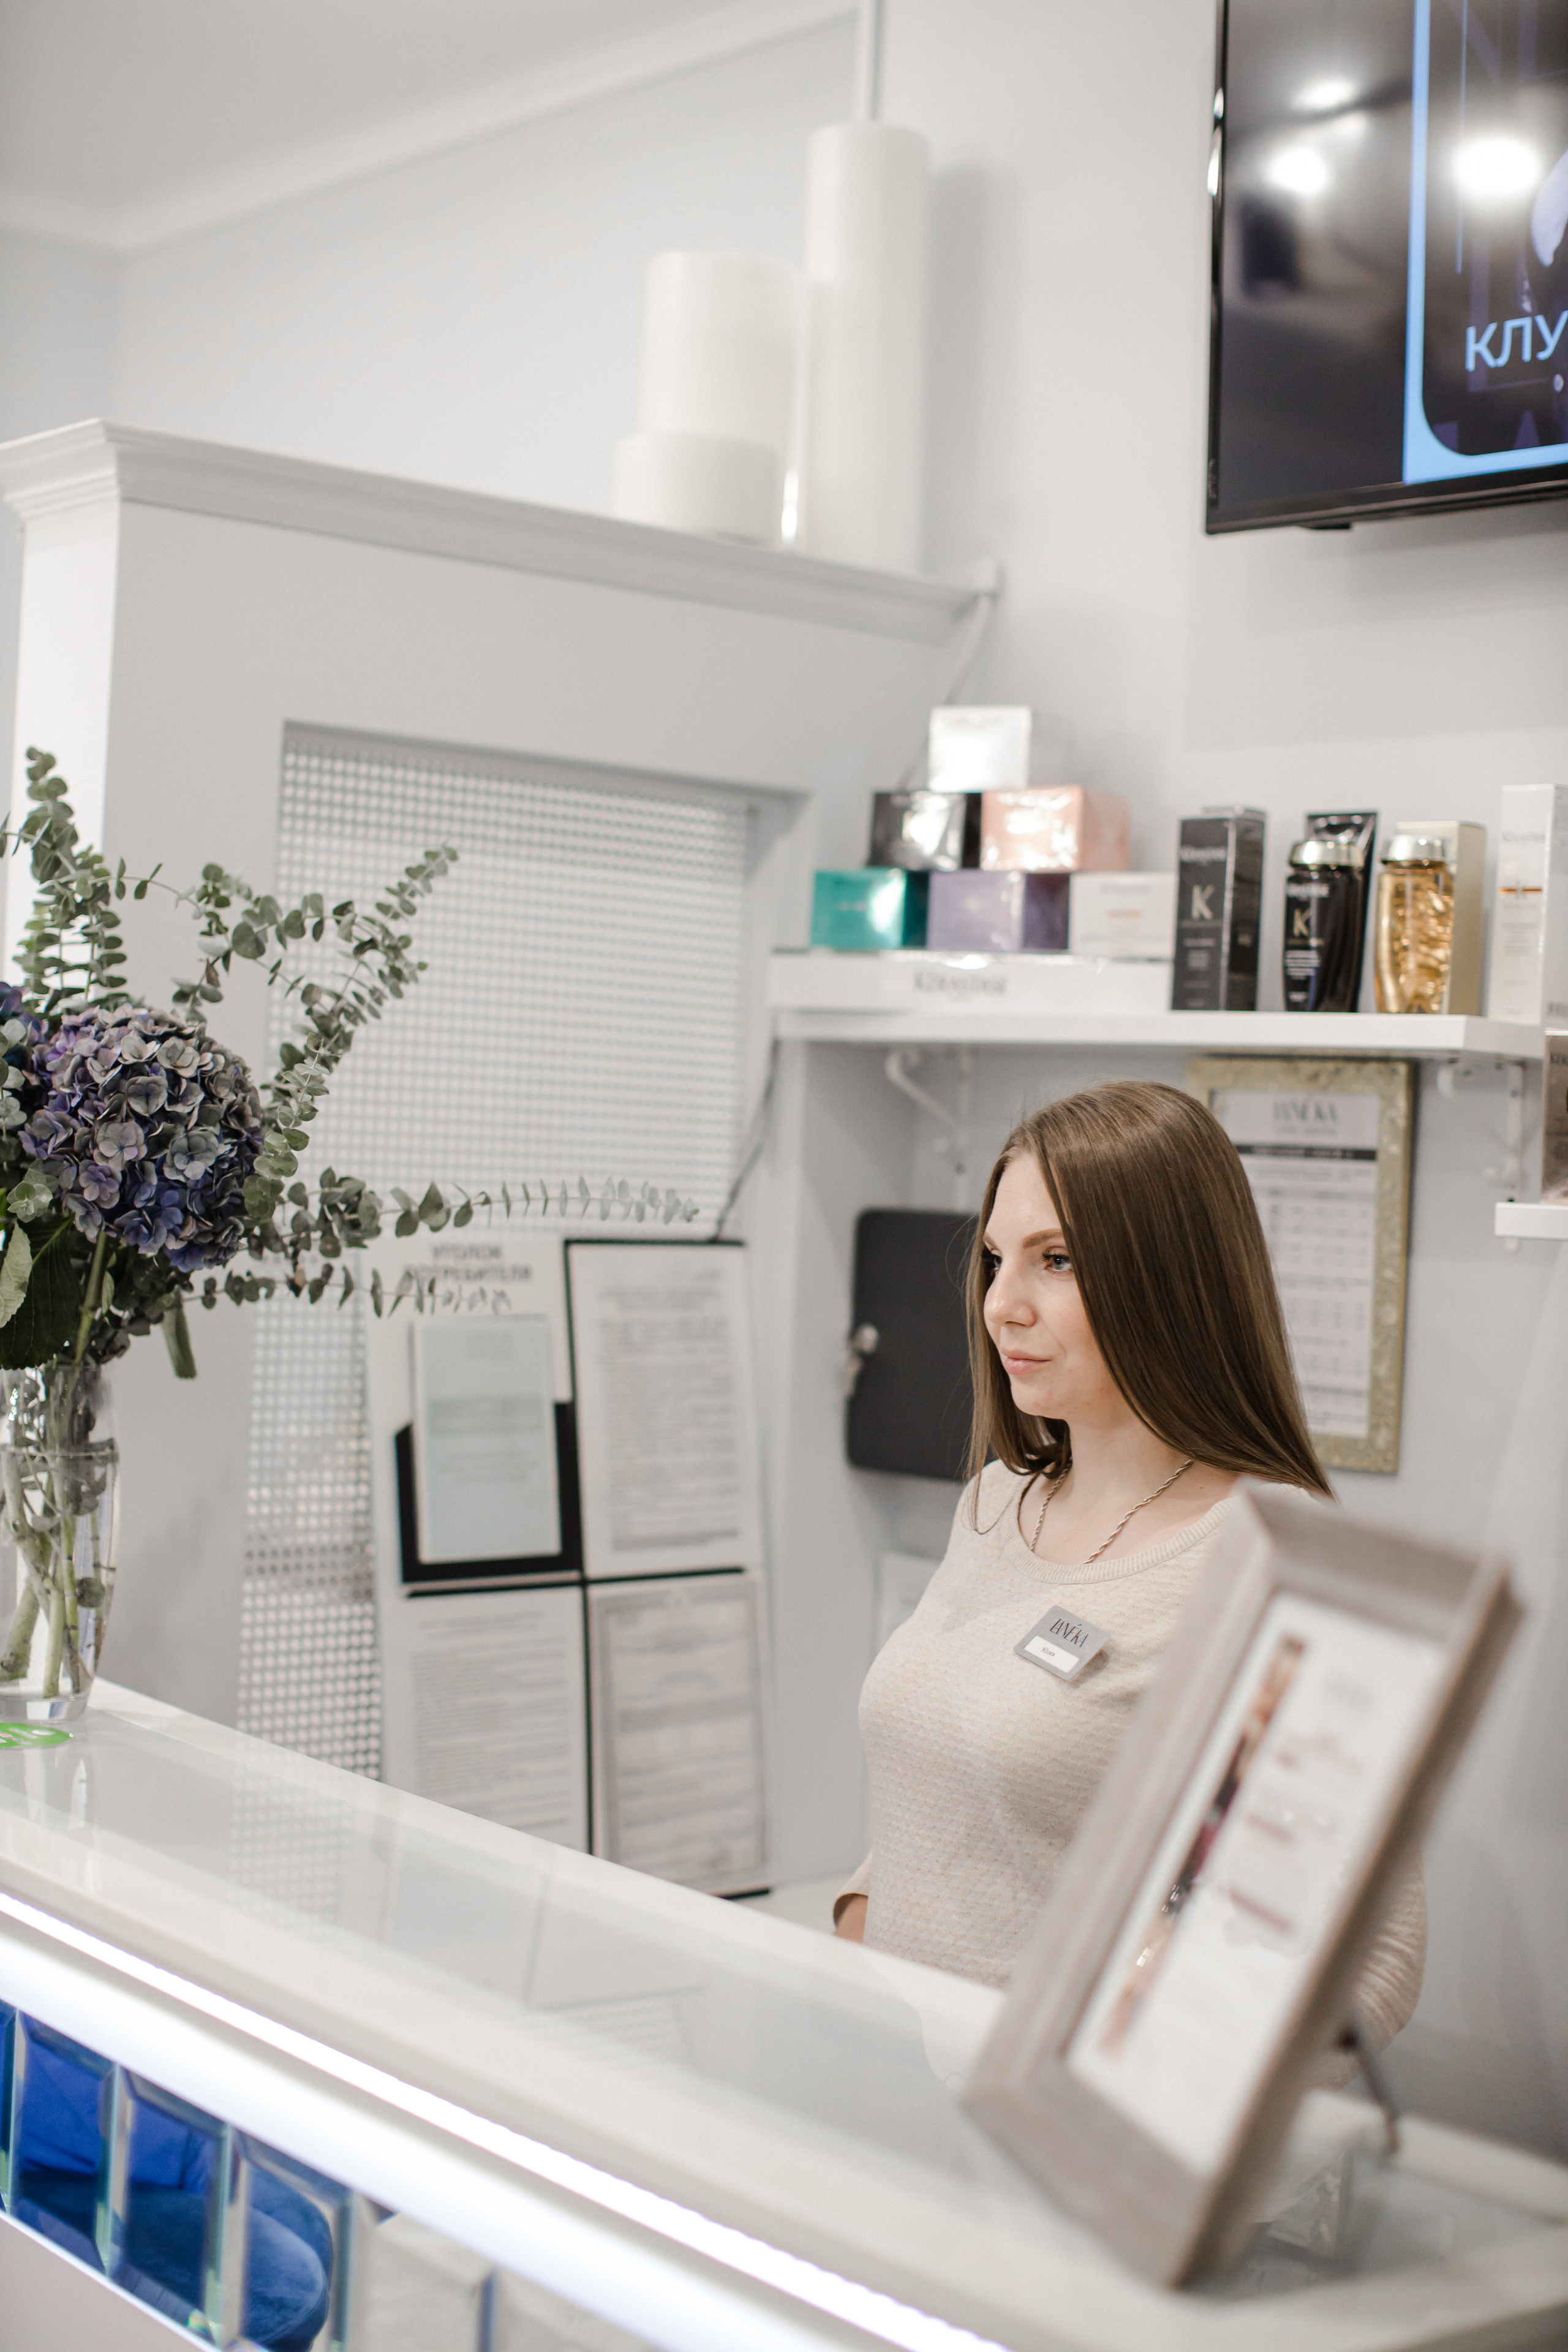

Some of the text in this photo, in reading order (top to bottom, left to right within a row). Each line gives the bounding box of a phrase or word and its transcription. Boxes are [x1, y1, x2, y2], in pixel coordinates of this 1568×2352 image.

[1192, 884, 1215, 919] K
[1294, 908, 1313, 936] K
[1049, 1618, 1088, 1648] LANÉKA
